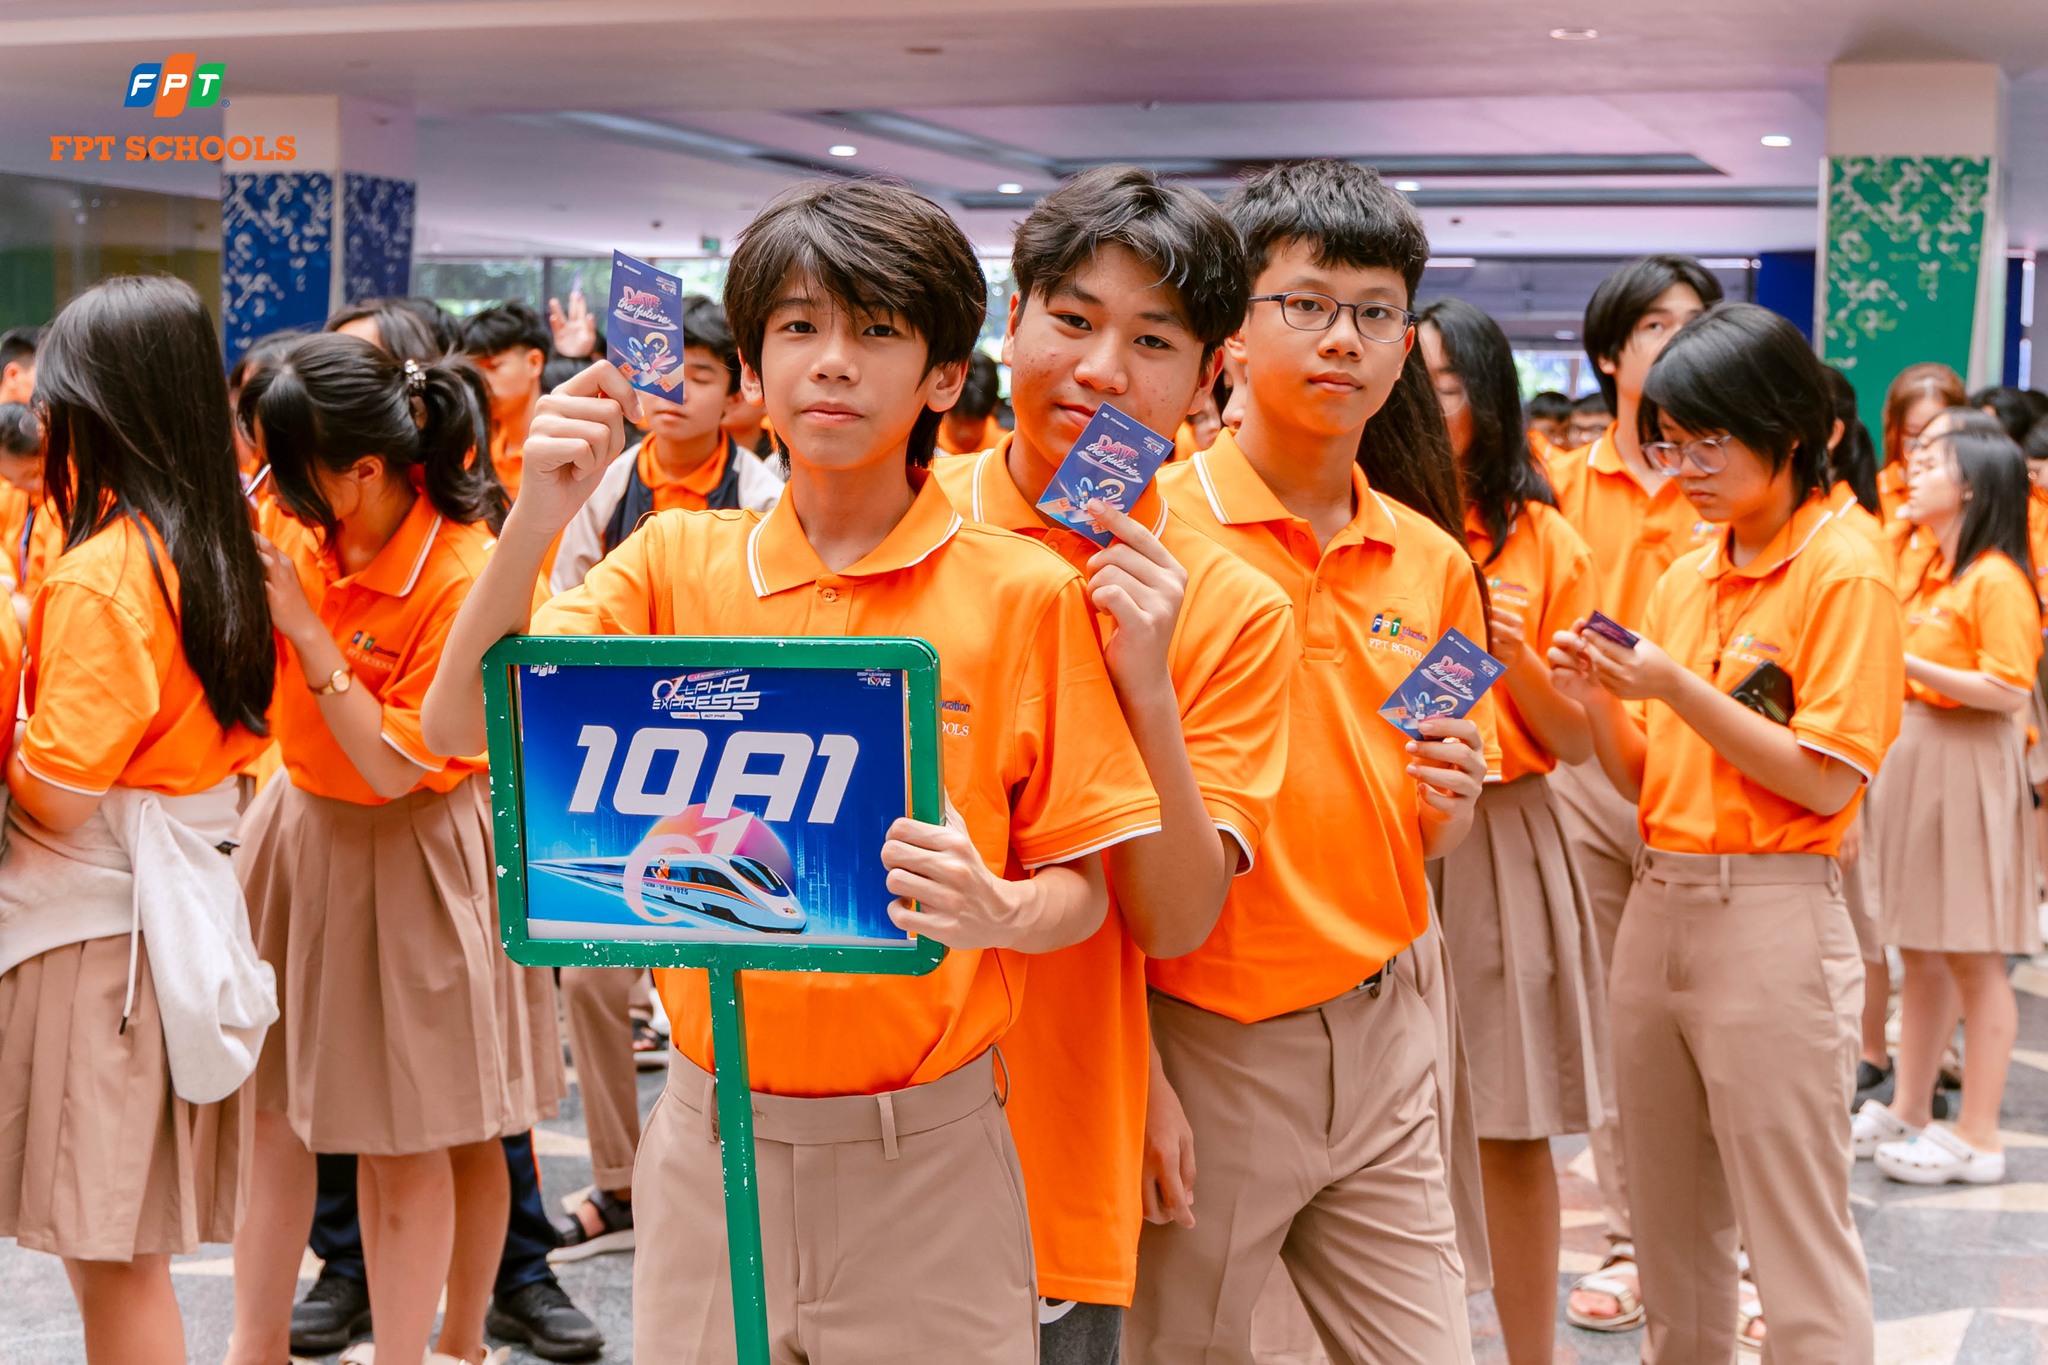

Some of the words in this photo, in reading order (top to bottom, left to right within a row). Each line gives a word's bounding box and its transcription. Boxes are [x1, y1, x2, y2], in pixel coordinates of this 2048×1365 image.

[617, 297, 636, 311] the
[634, 305, 671, 322] future
[623, 286, 660, 310] DATE
[1085, 442, 1107, 458] the
[1103, 454, 1140, 477] future
[1096, 434, 1139, 462] DATE
[1368, 638, 1390, 650] FPT
[1391, 641, 1425, 659] SCHOOL
[1439, 654, 1475, 679] DATE
[1439, 673, 1474, 695] future
[651, 691, 761, 710] EXPRESS
[941, 720, 970, 737] OOLS
